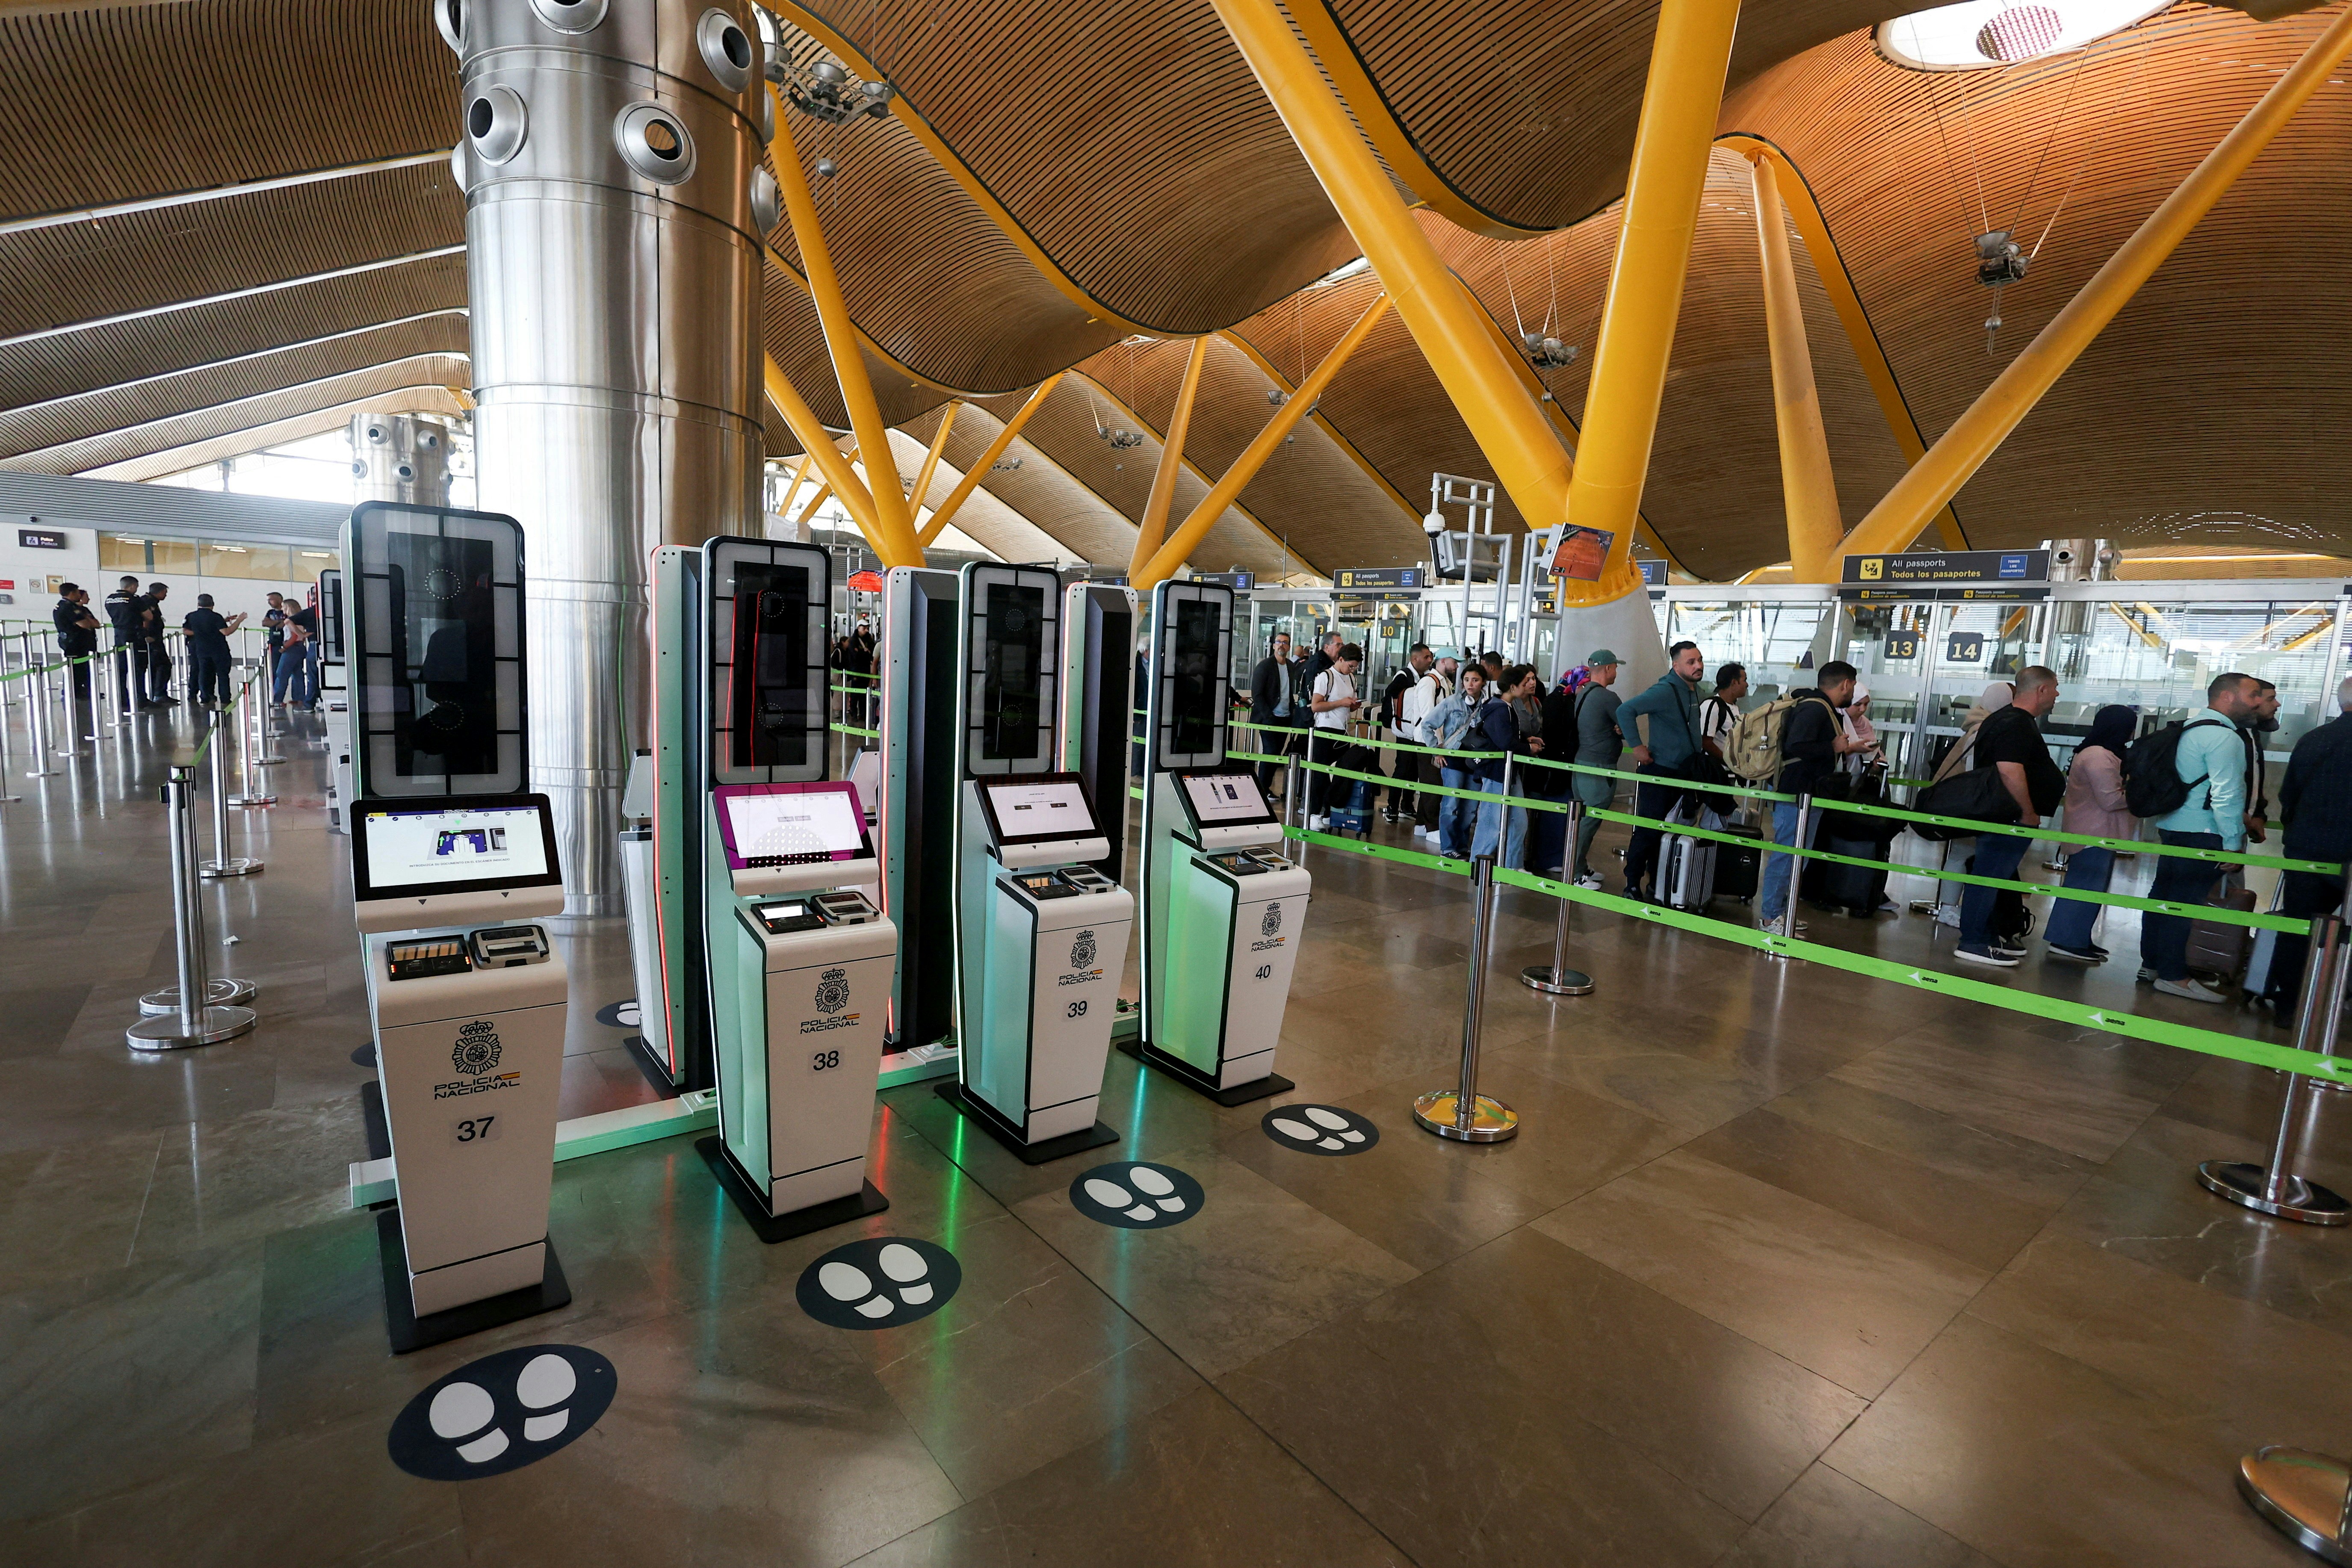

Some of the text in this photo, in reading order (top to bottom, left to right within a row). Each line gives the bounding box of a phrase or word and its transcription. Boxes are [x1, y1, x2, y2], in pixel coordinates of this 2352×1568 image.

[1906, 559, 1946, 568] passports
[1933, 570, 1981, 579] pasaportes
[1383, 626, 1394, 636] 10
[1510, 629, 1516, 640] 1
[1890, 641, 1913, 656] 13
[1952, 643, 1977, 659] 14
[1251, 943, 1284, 952] NACIONAL
[1252, 939, 1278, 947] POLICIA
[1059, 971, 1094, 981] POLICIA
[1256, 965, 1271, 980] 40
[1058, 976, 1102, 986] NACIONAL
[1068, 1001, 1087, 1018] 39
[800, 1020, 859, 1034] NACIONAL
[801, 1015, 848, 1028] POLICIA
[813, 1050, 839, 1071] 38
[434, 1075, 502, 1092] POLICIA
[434, 1080, 520, 1100] NACIONAL
[457, 1116, 494, 1142] 37
